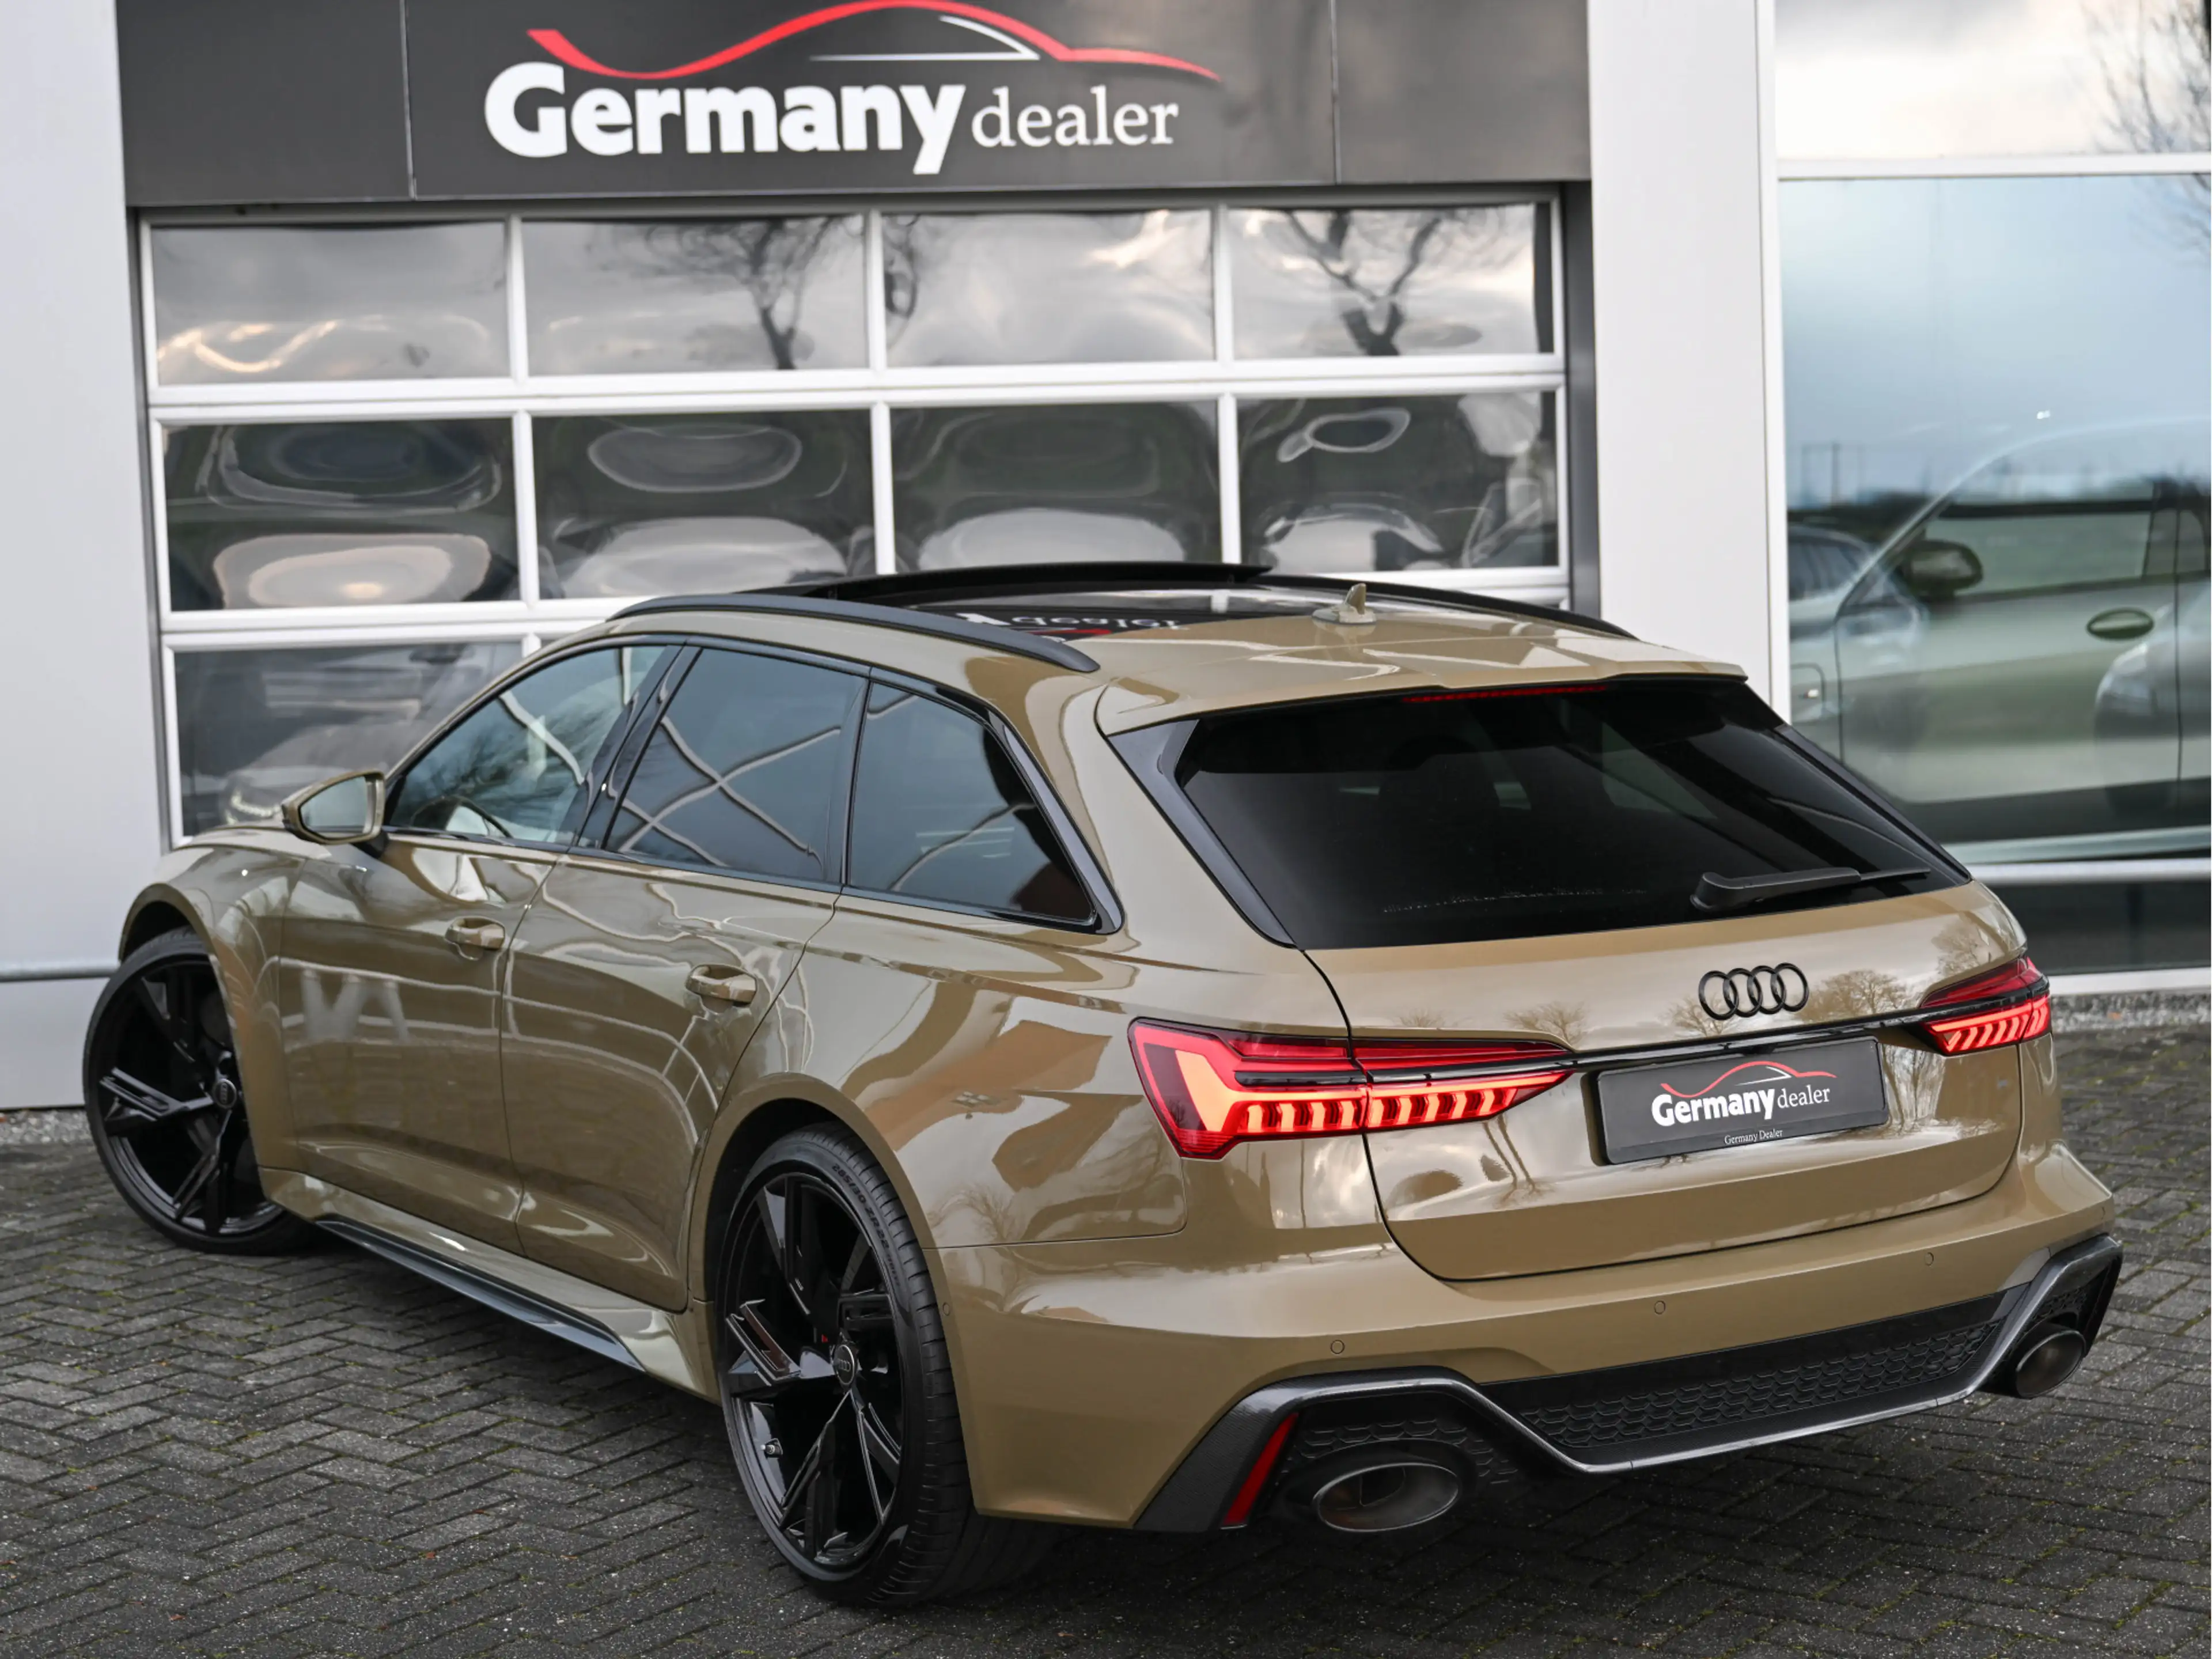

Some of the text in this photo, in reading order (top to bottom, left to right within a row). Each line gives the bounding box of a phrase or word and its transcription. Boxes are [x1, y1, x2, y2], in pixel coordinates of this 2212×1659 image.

[484, 61, 1179, 175] Germany dealer
[1651, 1085, 1831, 1127] Germany dealer
[1724, 1128, 1783, 1145] Germany Dealer
[831, 1162, 866, 1203] 285/30
